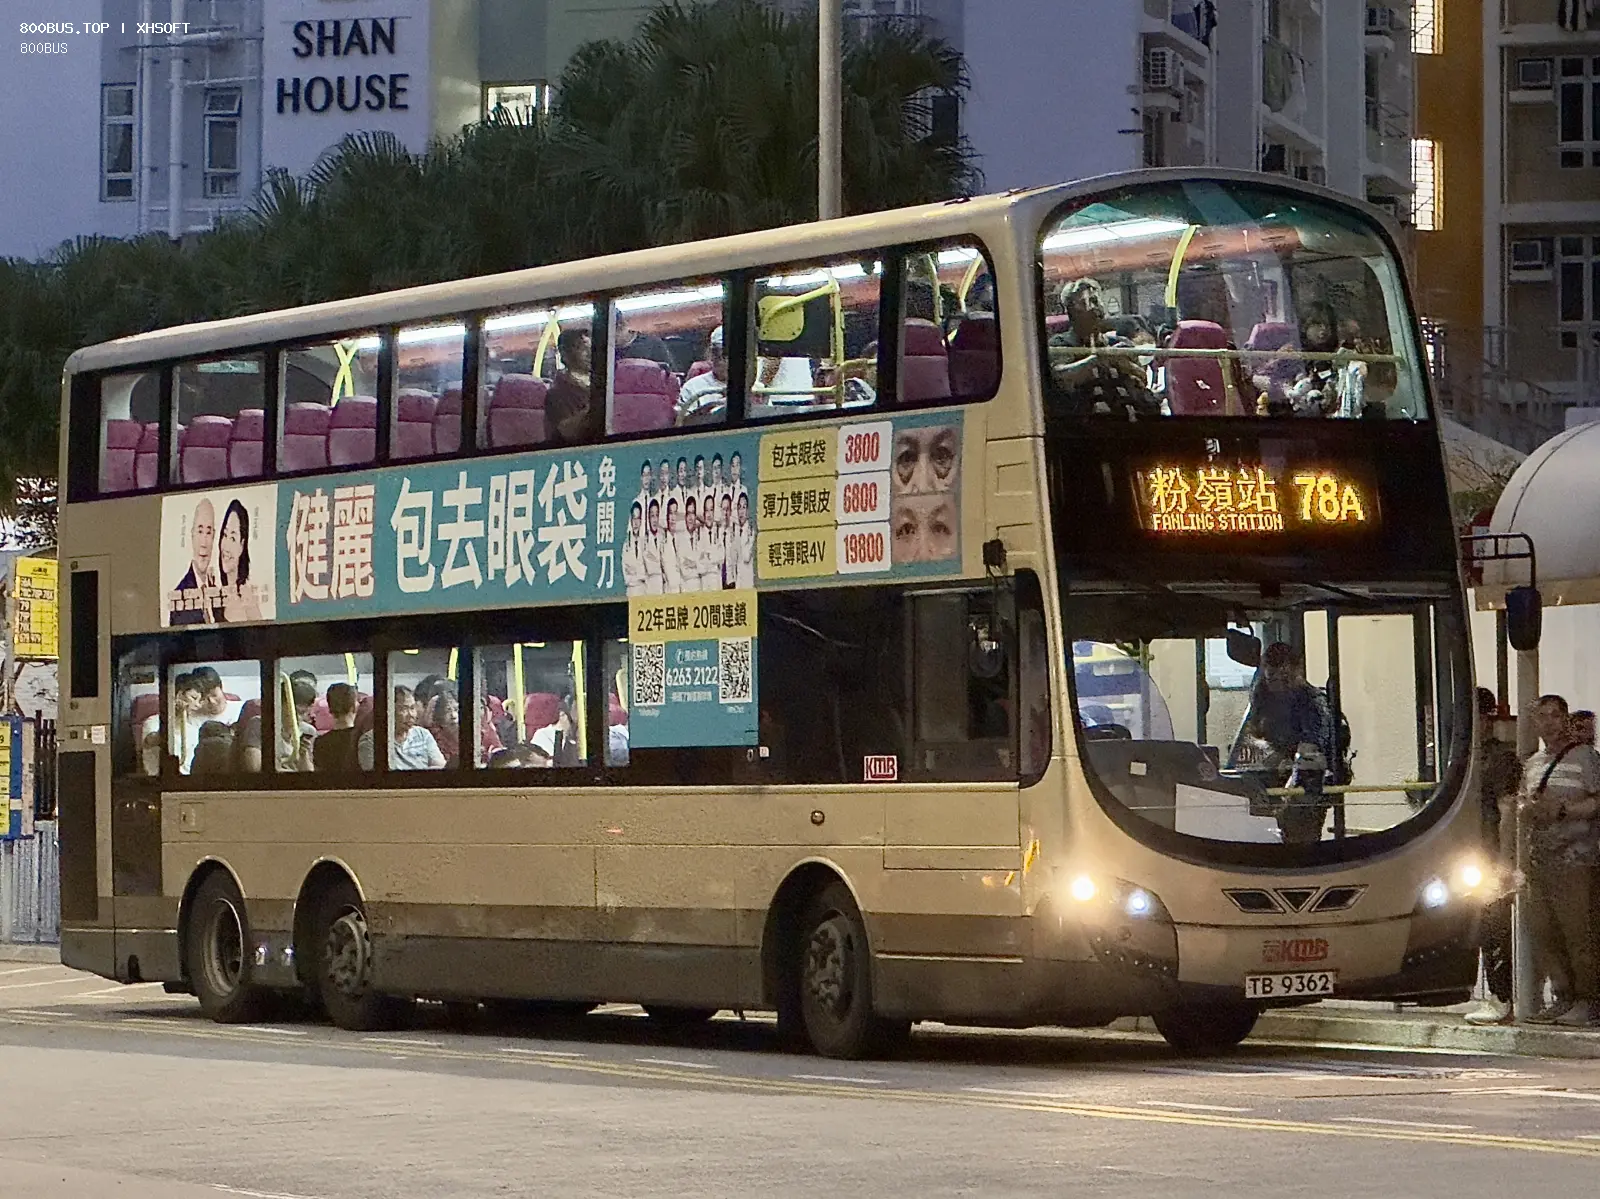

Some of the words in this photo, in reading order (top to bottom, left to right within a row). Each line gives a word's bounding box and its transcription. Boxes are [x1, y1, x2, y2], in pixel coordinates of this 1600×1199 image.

[292, 18, 396, 58] SHAN
[276, 73, 410, 114] HOUSE
[772, 439, 827, 468] 包去眼袋
[845, 431, 880, 464] 3800
[763, 488, 831, 518] 彈力雙眼皮
[843, 482, 878, 513] 6800
[1150, 466, 1277, 514] 粉嶺站
[1294, 475, 1366, 521] 78A
[286, 484, 375, 603] 健麗
[390, 460, 588, 593] 包去眼袋
[597, 455, 616, 589] 免開刀
[1152, 513, 1215, 531] FANLING
[1218, 513, 1284, 531] STATION
[768, 541, 826, 568] 輕薄眼4V
[843, 532, 884, 564] 19800
[637, 605, 689, 631] 22年品牌
[693, 602, 747, 629] 20間連鎖
[666, 668, 692, 687] 6263
[693, 666, 718, 686] 2122
[865, 757, 896, 779] KMB
[1281, 939, 1329, 961] KMB
[1249, 977, 1274, 995] TB
[1281, 974, 1330, 994] 9362
